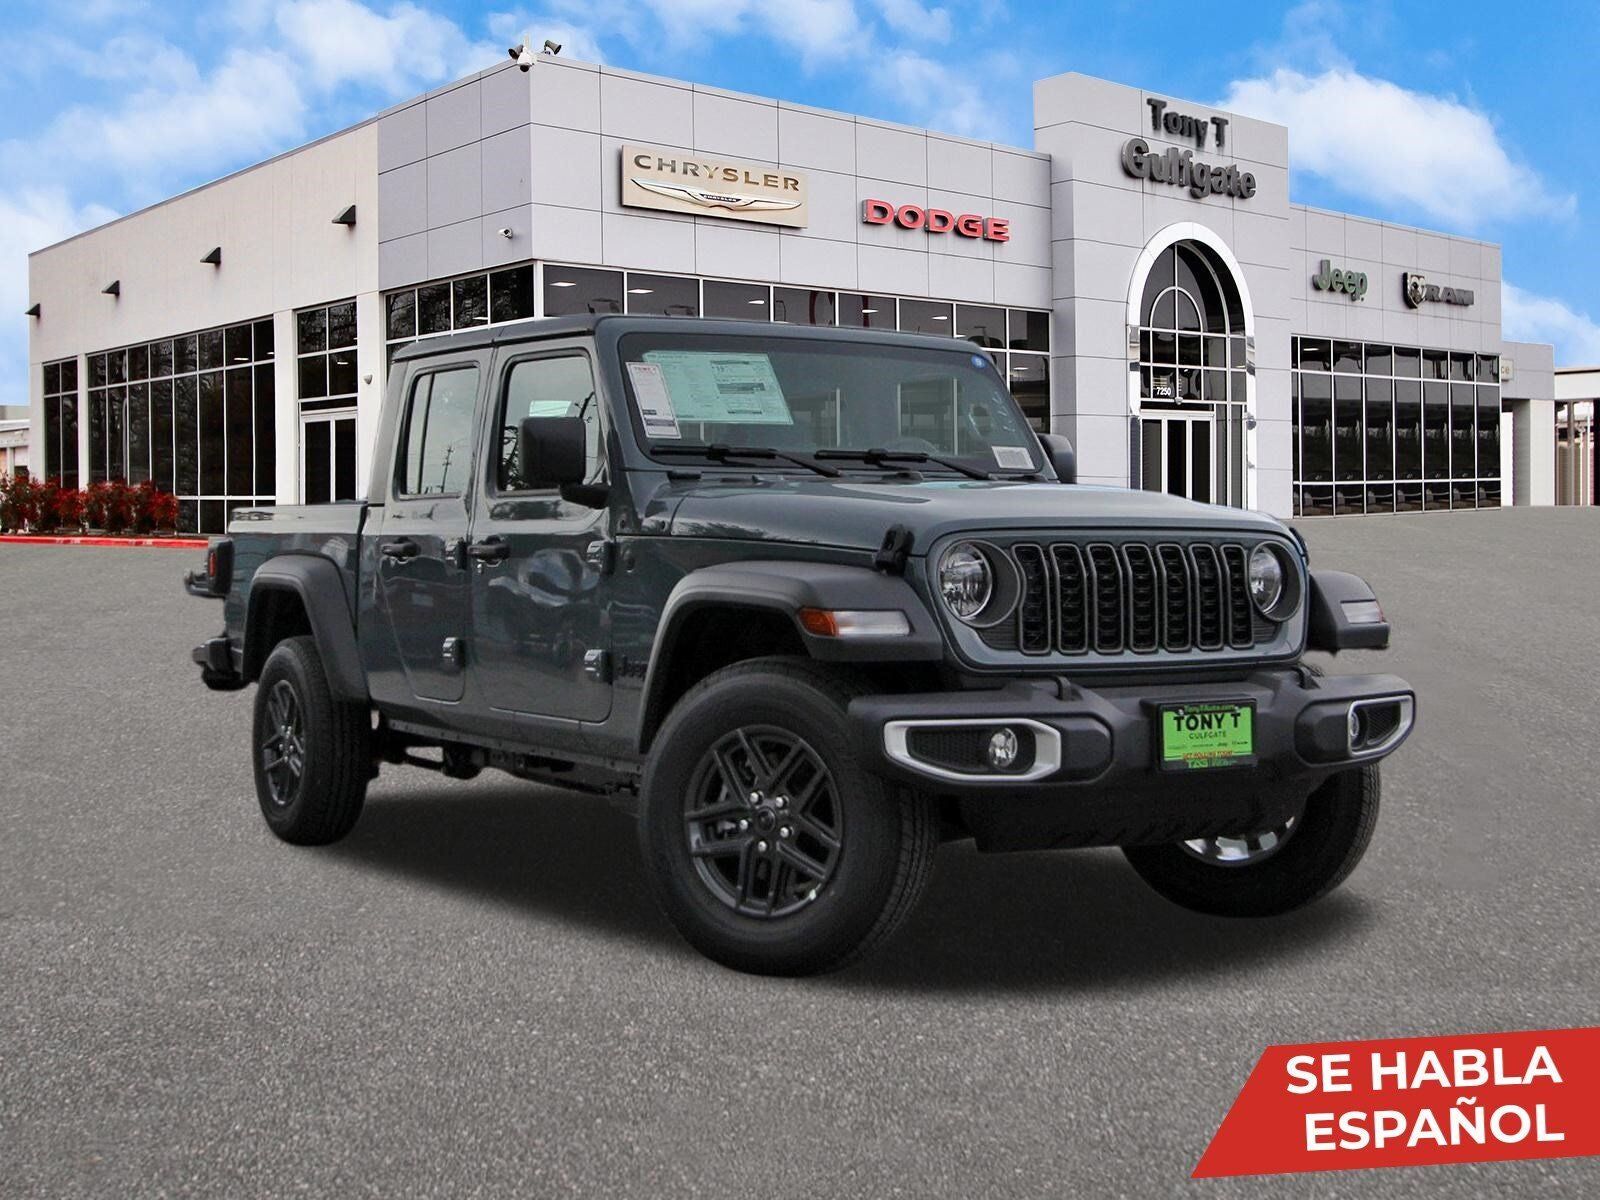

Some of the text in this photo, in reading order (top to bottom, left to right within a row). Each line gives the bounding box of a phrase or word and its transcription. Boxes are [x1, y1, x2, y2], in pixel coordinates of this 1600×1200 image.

[1147, 98, 1229, 148] Tony T
[634, 154, 800, 192] CHRYSLER
[1121, 138, 1257, 199] Gulfgate
[862, 198, 1011, 242] DODGE
[1313, 260, 1368, 303] Jeep
[1425, 284, 1475, 306] RAM
[1156, 386, 1171, 396] 7250
[1173, 713, 1240, 731] TONY T
